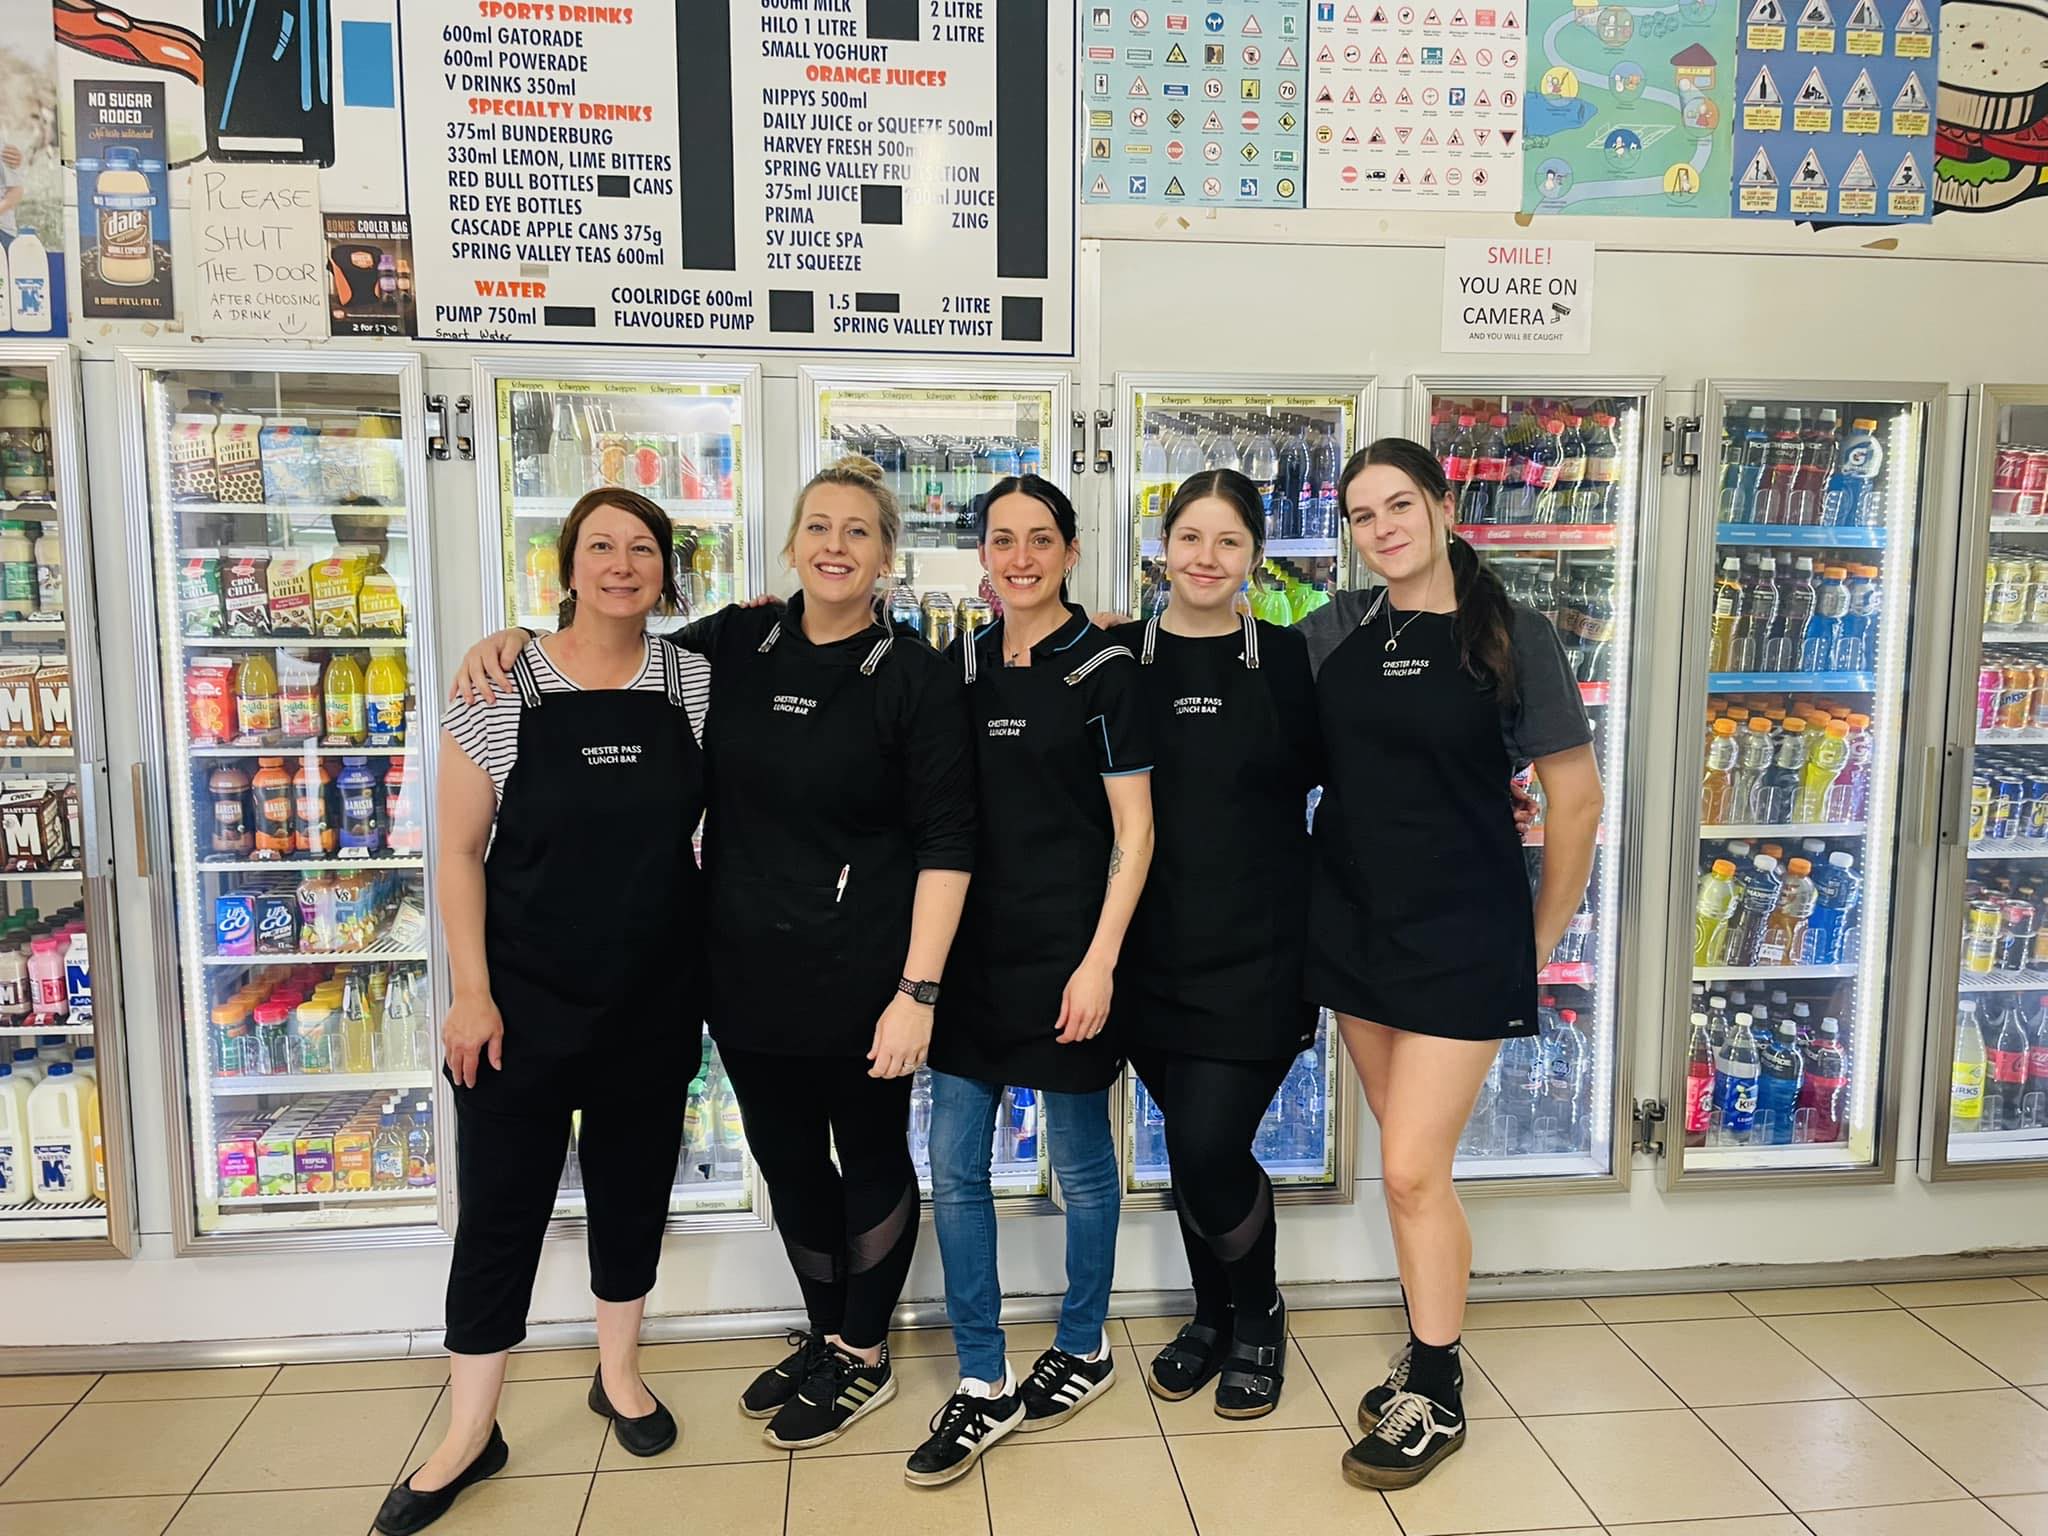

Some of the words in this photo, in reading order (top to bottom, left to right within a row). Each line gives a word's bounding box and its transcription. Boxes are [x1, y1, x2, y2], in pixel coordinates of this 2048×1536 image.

[479, 1, 554, 20] SPORTS
[559, 5, 632, 24] DRINKS
[814, 0, 851, 12] MILK
[931, 1, 938, 17] 2
[945, 1, 982, 19] LITRE
[762, 16, 797, 33] HILO
[805, 18, 810, 34] 1
[818, 19, 856, 36] LITRE
[933, 25, 940, 40] 2
[947, 25, 984, 43] LITRE
[443, 25, 491, 43] 600ml
[498, 28, 583, 47] GATORADE
[762, 40, 810, 58] SMALL
[814, 43, 888, 62] YOGHURT
[444, 49, 492, 68] 600ml
[499, 52, 587, 72] POWERADE
[806, 65, 880, 84] ORANGE
[886, 69, 946, 86] JUICES
[445, 74, 456, 90] V
[462, 74, 521, 93] DRINKS
[528, 77, 575, 96] 350ml
[1207, 84, 1219, 92] 15
[1282, 87, 1293, 95] 70
[89, 92, 105, 107] NO
[110, 93, 152, 108] SUGAR
[763, 88, 815, 106] NIPPYS
[821, 91, 866, 108] 500ml
[100, 110, 141, 123] ADDED
[469, 98, 573, 118] SPECIALTY
[579, 103, 652, 121] DRINKS
[764, 112, 806, 129] DAILY
[811, 114, 852, 131] JUICE
[858, 121, 872, 132] or
[949, 120, 992, 137] 500ml
[447, 122, 495, 140] 375ml
[502, 125, 612, 145] BUNDERBURG
[764, 136, 822, 154] HARVEY
[828, 138, 871, 156] FRESH
[878, 140, 912, 156] 500m
[448, 146, 496, 164] 330ml
[503, 149, 563, 170] LEMON,
[570, 151, 605, 168] LIME
[612, 153, 671, 171] BITTERS
[765, 160, 821, 177] SPRING
[826, 162, 878, 179] VALLEY
[205, 172, 312, 211] PLEASE
[449, 171, 478, 187] RED
[485, 172, 524, 189] BULL
[529, 174, 593, 192] BOTTLES
[634, 178, 673, 195] CANS
[766, 183, 811, 200] 375ml
[817, 185, 858, 202] JUICE
[955, 190, 995, 206] JUICE
[450, 194, 479, 211] RED
[486, 196, 511, 212] EYE
[517, 197, 582, 215] BOTTLES
[108, 211, 141, 235] dare
[766, 206, 814, 223] PRIMA
[952, 213, 988, 229] ZING
[327, 219, 355, 232] BONUS
[358, 221, 389, 232] COOLER
[392, 221, 408, 232] BAG
[451, 219, 520, 236] CASCADE
[527, 221, 572, 238] APPLE
[579, 223, 618, 240] CANS
[624, 225, 661, 246] 375g
[205, 225, 293, 252] SHUT
[767, 230, 784, 245] SV
[789, 230, 830, 247] JUICE
[836, 232, 863, 248] SPA
[452, 242, 511, 260] SPRING
[516, 244, 571, 262] VALLEY
[576, 246, 611, 263] TEAS
[617, 248, 663, 265] 600ml
[767, 253, 791, 269] 2LT
[797, 254, 861, 271] SQUEEZE
[1488, 247, 1551, 264] SMILE!
[198, 258, 246, 284] THE
[254, 264, 317, 282] DOOR
[475, 281, 545, 298] WATER
[1459, 277, 1499, 294] YOU
[1506, 278, 1542, 294] ARE
[1549, 279, 1577, 295] ON
[211, 294, 251, 305] AFTER
[256, 293, 320, 306] CHOOSING
[612, 288, 700, 305] COOLRIDGE
[706, 290, 752, 307] 600ml
[829, 294, 849, 310] 1.5
[942, 297, 949, 312] 2
[213, 310, 222, 319] A
[230, 310, 271, 320] DRINK
[436, 306, 482, 322] PUMP
[488, 307, 536, 324] 750ml
[615, 311, 704, 328] FLAVOURED
[710, 313, 754, 330] PUMP
[1463, 308, 1544, 325] CAMERA
[361, 323, 373, 331] for
[436, 328, 469, 339] Smart
[480, 329, 512, 340] Water
[834, 317, 888, 333] SPRING
[893, 318, 944, 335] VALLEY
[949, 320, 993, 336] TWIST
[511, 381, 544, 389] Schweppes
[558, 383, 590, 391] Schweppes
[1161, 396, 1191, 405] Schweppes
[1203, 396, 1232, 405] Schweppes
[220, 449, 254, 462] CHILL
[232, 577, 255, 586] CHOC
[272, 576, 305, 586] MOCHA
[228, 584, 264, 597] CHILL
[272, 584, 305, 597] CHILL
[40, 688, 72, 731] M
[773, 704, 794, 713] LUNCH
[795, 706, 808, 715] BAR
[774, 696, 798, 704] CHESTER
[799, 698, 816, 708] PASS
[1174, 697, 1201, 707] CHESTER
[1203, 697, 1222, 706] PASS
[1176, 706, 1199, 715] LUNCH
[1201, 706, 1217, 714] BAR
[582, 746, 619, 756] CHESTER
[621, 745, 641, 753] PASS
[588, 756, 618, 765] LUNCH
[620, 755, 637, 763] BAR
[3, 814, 41, 855] M
[301, 890, 315, 903] V8
[335, 888, 349, 901] V8
